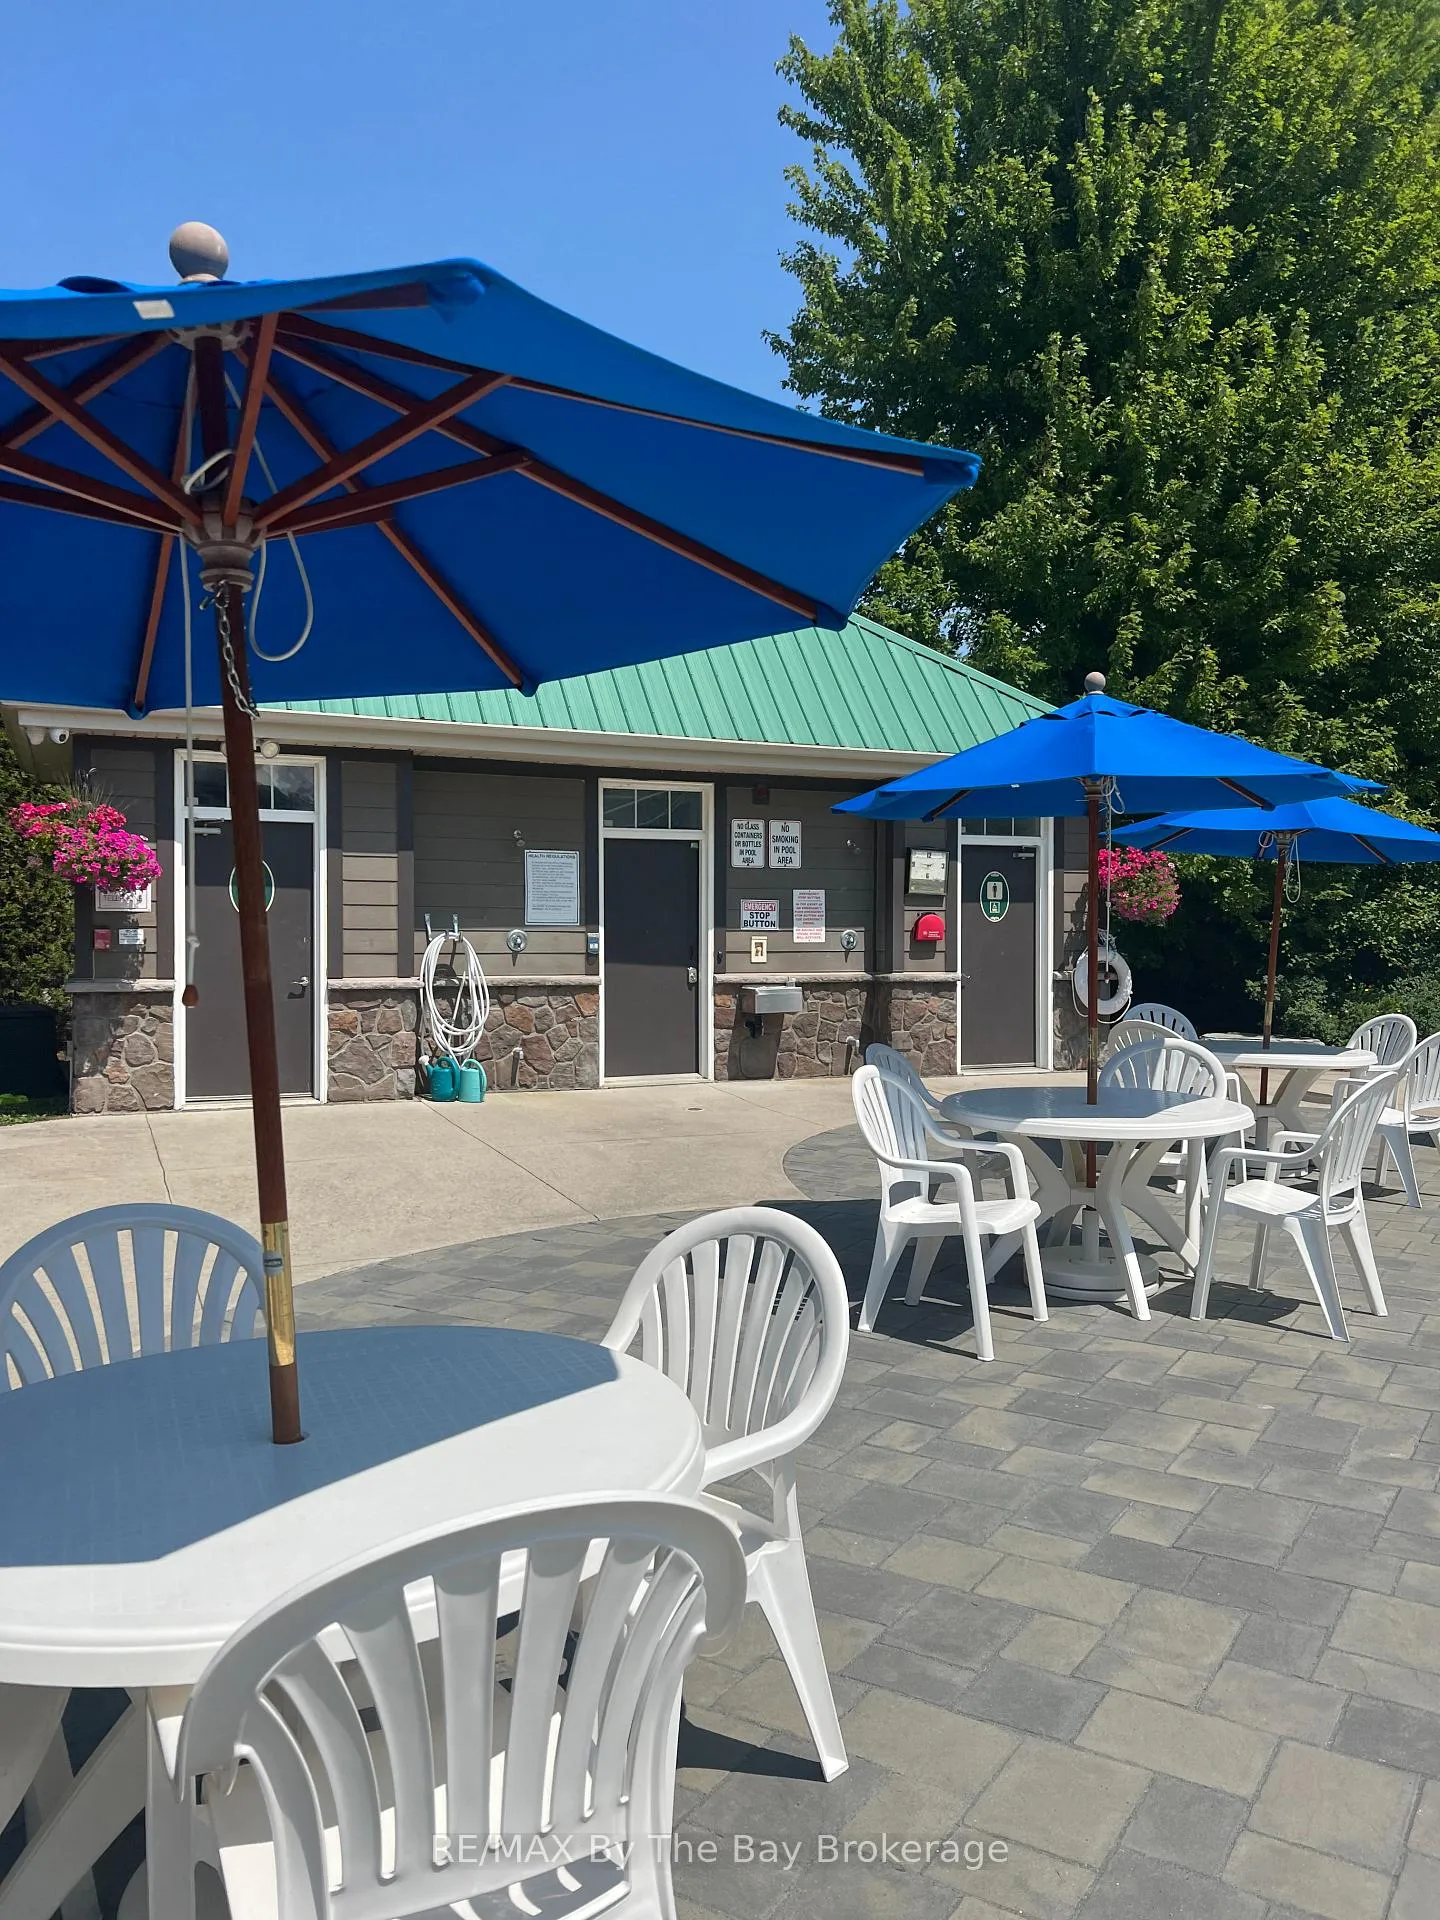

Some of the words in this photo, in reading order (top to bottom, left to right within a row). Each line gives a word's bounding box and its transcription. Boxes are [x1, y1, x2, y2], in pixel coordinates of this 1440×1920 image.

[781, 824, 790, 832] NO
[772, 835, 798, 843] SMOKING
[774, 846, 780, 854] IN
[781, 846, 796, 854] POOL
[744, 903, 776, 911] EMERGENCY
[743, 920, 776, 928] BUTTON
